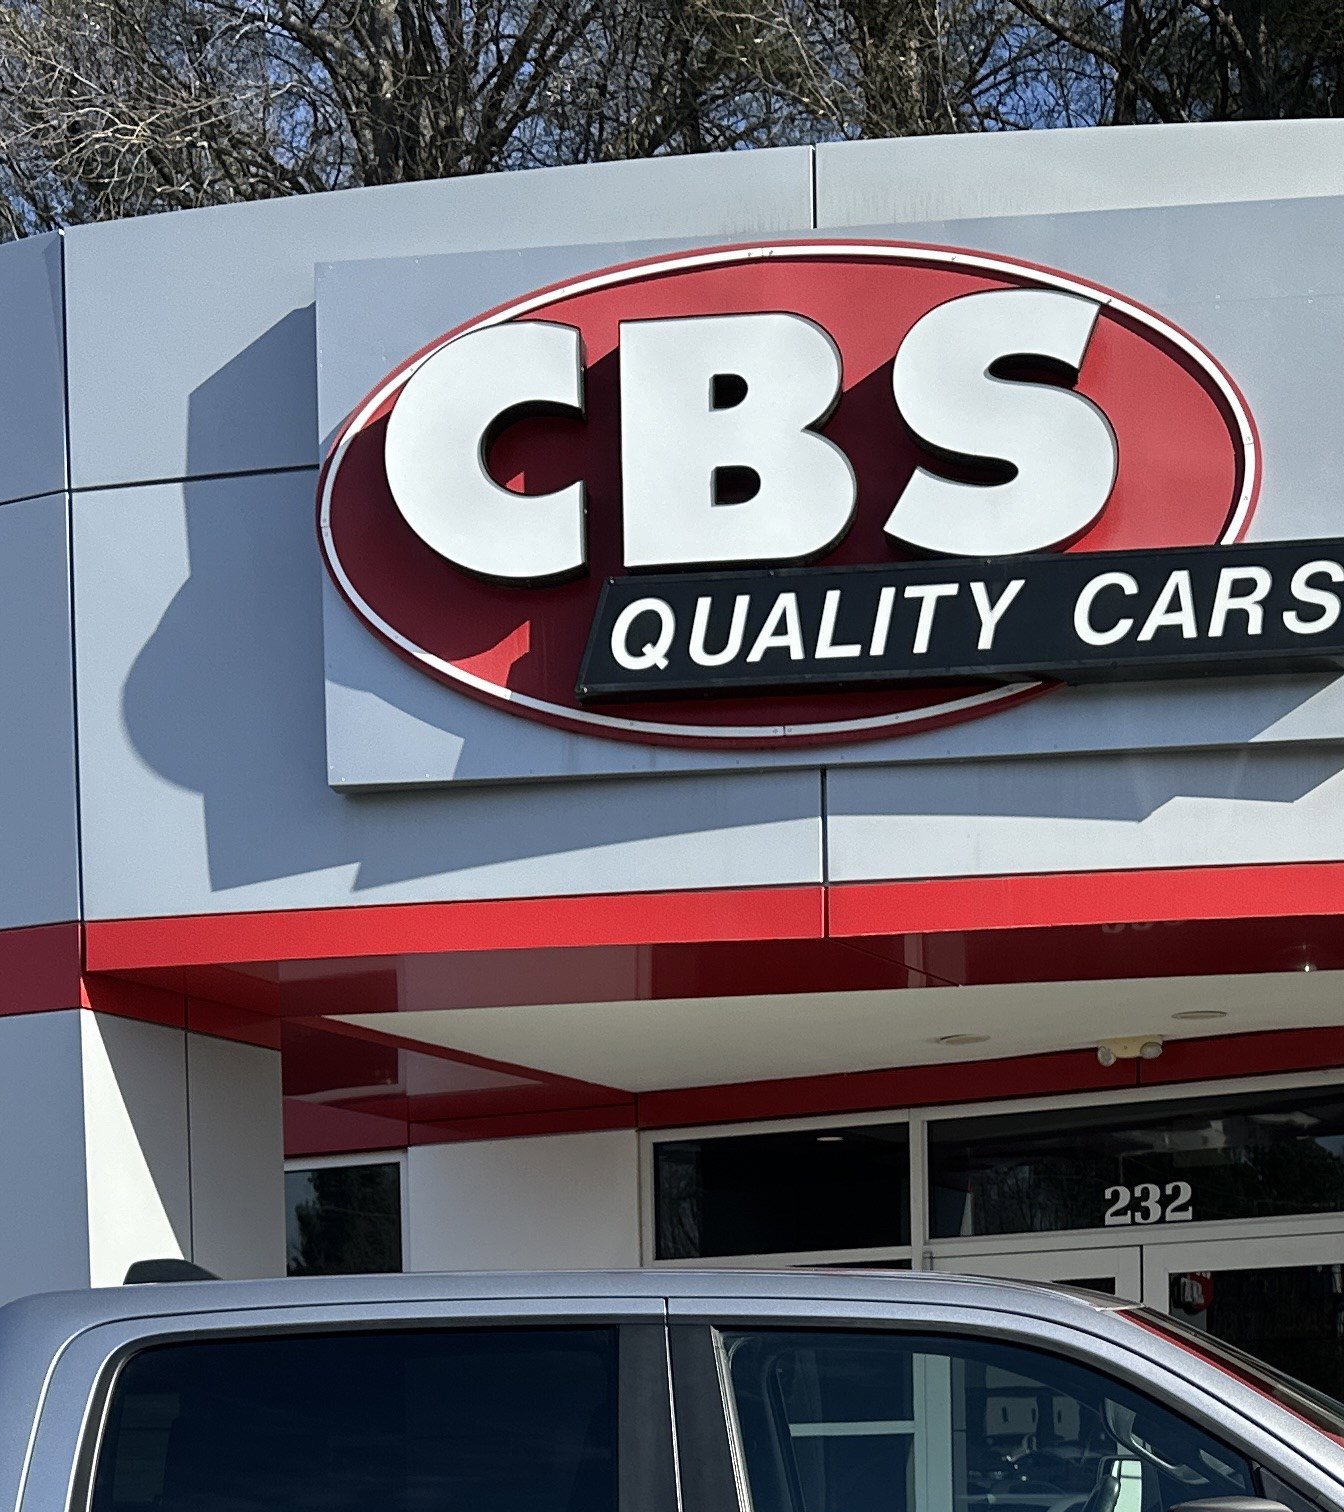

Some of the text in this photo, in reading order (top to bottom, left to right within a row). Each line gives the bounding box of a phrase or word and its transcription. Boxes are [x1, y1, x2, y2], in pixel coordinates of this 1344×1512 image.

[384, 288, 1119, 581] CBS
[609, 578, 1026, 671] QUALITY
[1104, 1181, 1193, 1226] 232
